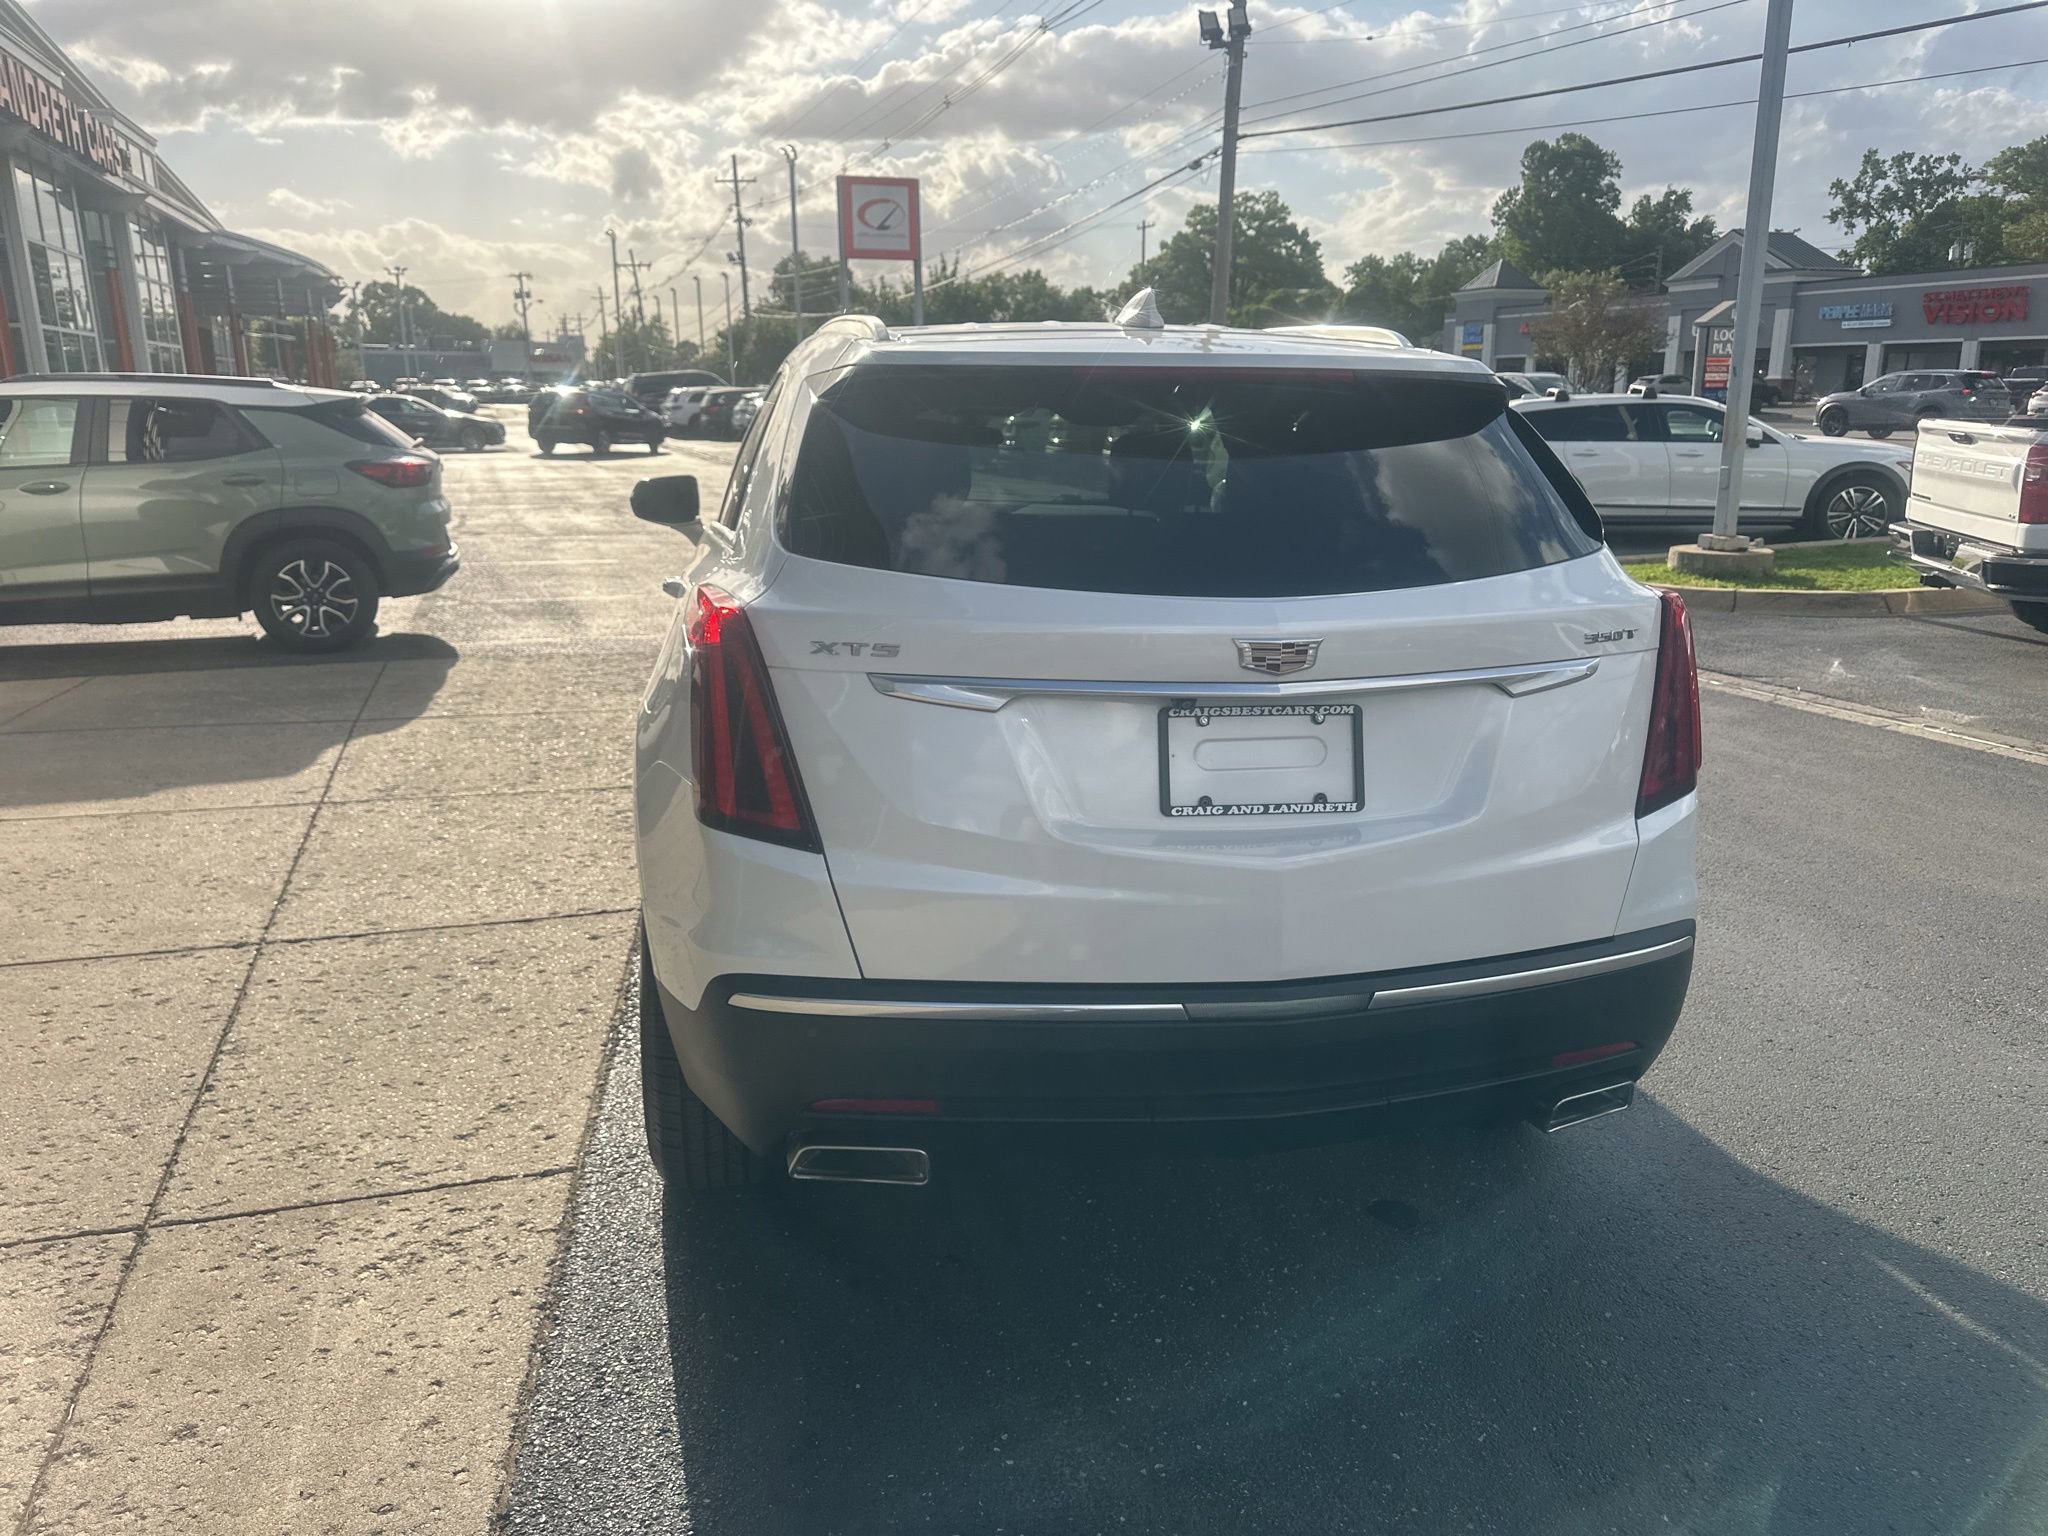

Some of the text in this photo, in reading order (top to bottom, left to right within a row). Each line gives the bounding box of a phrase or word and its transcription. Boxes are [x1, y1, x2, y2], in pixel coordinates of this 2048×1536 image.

[84, 111, 123, 177] CARS
[1923, 302, 2027, 325] VISION
[1917, 452, 2012, 480] CHEVROLET
[1168, 705, 1355, 717] CRAIGSBESTCARS.COM
[1171, 803, 1358, 817] CRAIG AND LANDRETH
